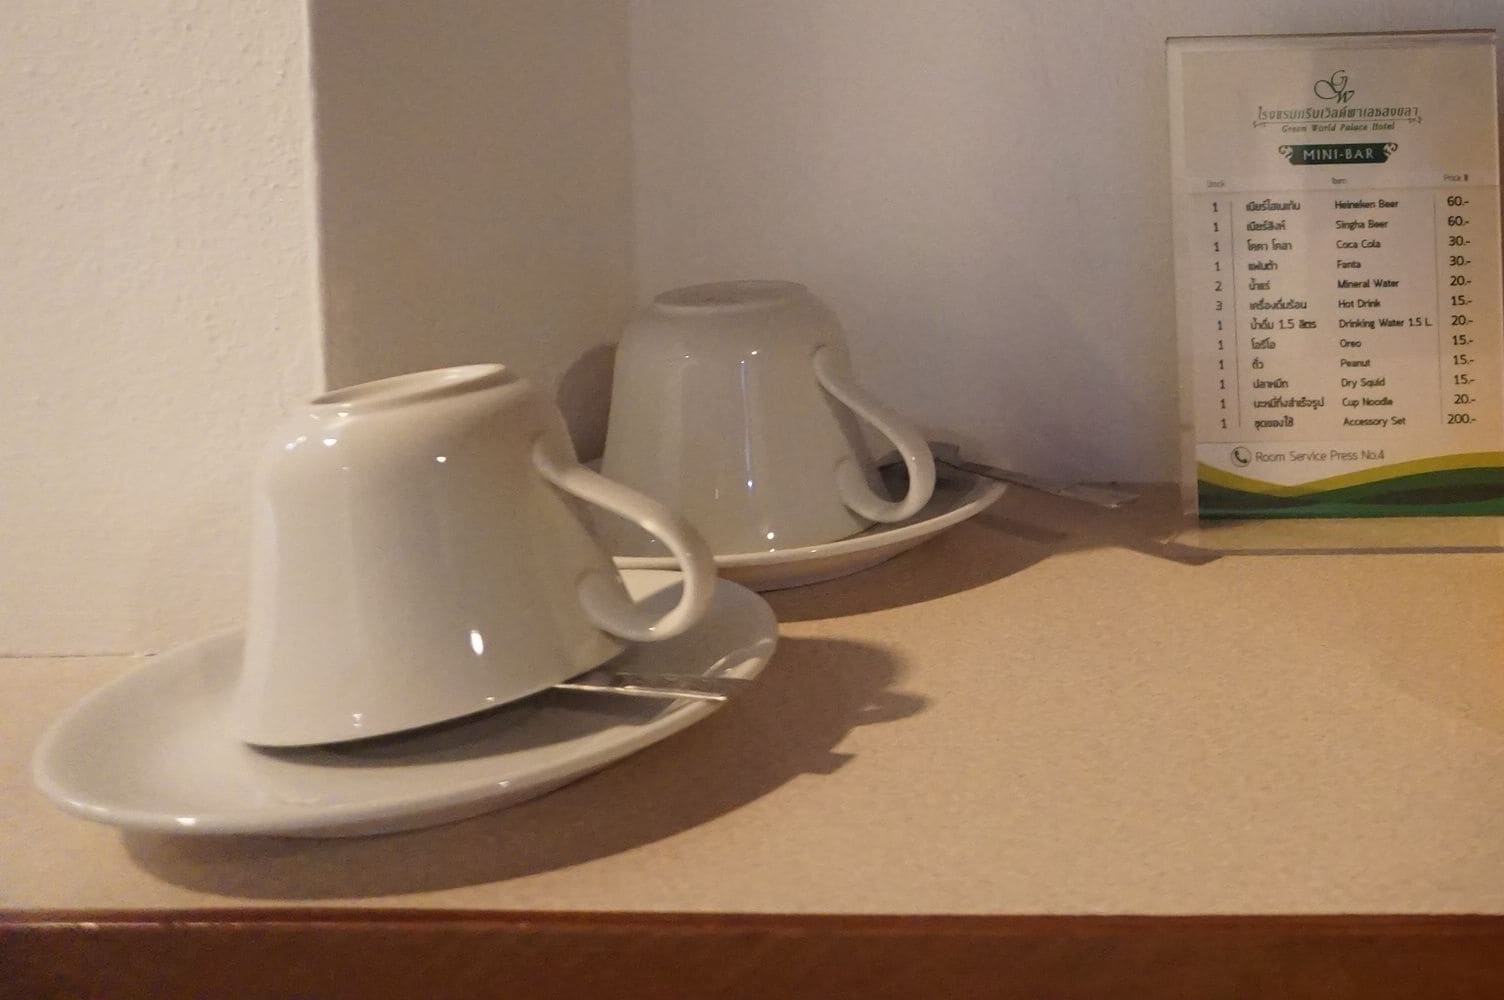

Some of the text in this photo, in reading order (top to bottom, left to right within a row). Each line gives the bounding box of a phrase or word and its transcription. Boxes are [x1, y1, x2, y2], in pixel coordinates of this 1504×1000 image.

[1371, 121, 1396, 131] Hotel
[1303, 148, 1376, 161] MINI-BAR
[1212, 201, 1219, 213] 1
[1377, 198, 1400, 209] Beer
[1446, 195, 1470, 208] 60.-
[1212, 221, 1220, 233] 1
[1335, 218, 1389, 232] Singha Beer
[1447, 215, 1470, 227] 60.-
[1335, 238, 1382, 250] Coca Cola
[1448, 234, 1471, 247] 30.-
[1213, 241, 1221, 253] 1
[1213, 260, 1221, 272] 1
[1336, 259, 1362, 269] Fanta
[1448, 255, 1472, 267] 30.-
[1214, 280, 1223, 293] 2
[1337, 278, 1400, 289] Mineral Water
[1449, 274, 1472, 287] 20.-
[1215, 300, 1224, 312] 3
[1337, 298, 1382, 309] Hot Drink
[1450, 294, 1473, 307] 15.-
[1217, 319, 1224, 331] 1
[1278, 318, 1296, 330] 1.5
[1338, 318, 1376, 330] Drinking
[1378, 317, 1405, 328] Water
[1408, 316, 1423, 328] 1.5
[1450, 314, 1474, 327] 20.-
[1217, 339, 1225, 351] 1
[1339, 338, 1363, 349] Oreo
[1452, 334, 1474, 346] 15.-
[1218, 359, 1225, 371] 1
[1339, 358, 1371, 368] Peanut
[1452, 353, 1475, 366] 15.-
[1219, 378, 1226, 390] 1
[1340, 376, 1386, 390] Dry Squid
[1453, 373, 1476, 386] 15.-
[1219, 398, 1227, 410] 1
[1341, 396, 1394, 409] Cup Noodle
[1453, 393, 1477, 405] 20.-
[1220, 417, 1228, 430] 1
[1342, 415, 1407, 428] Accessory Set
[1446, 412, 1477, 425] 200.-
[1254, 451, 1286, 463] Room
[1288, 450, 1327, 462] Service
[1329, 449, 1359, 462] Press
